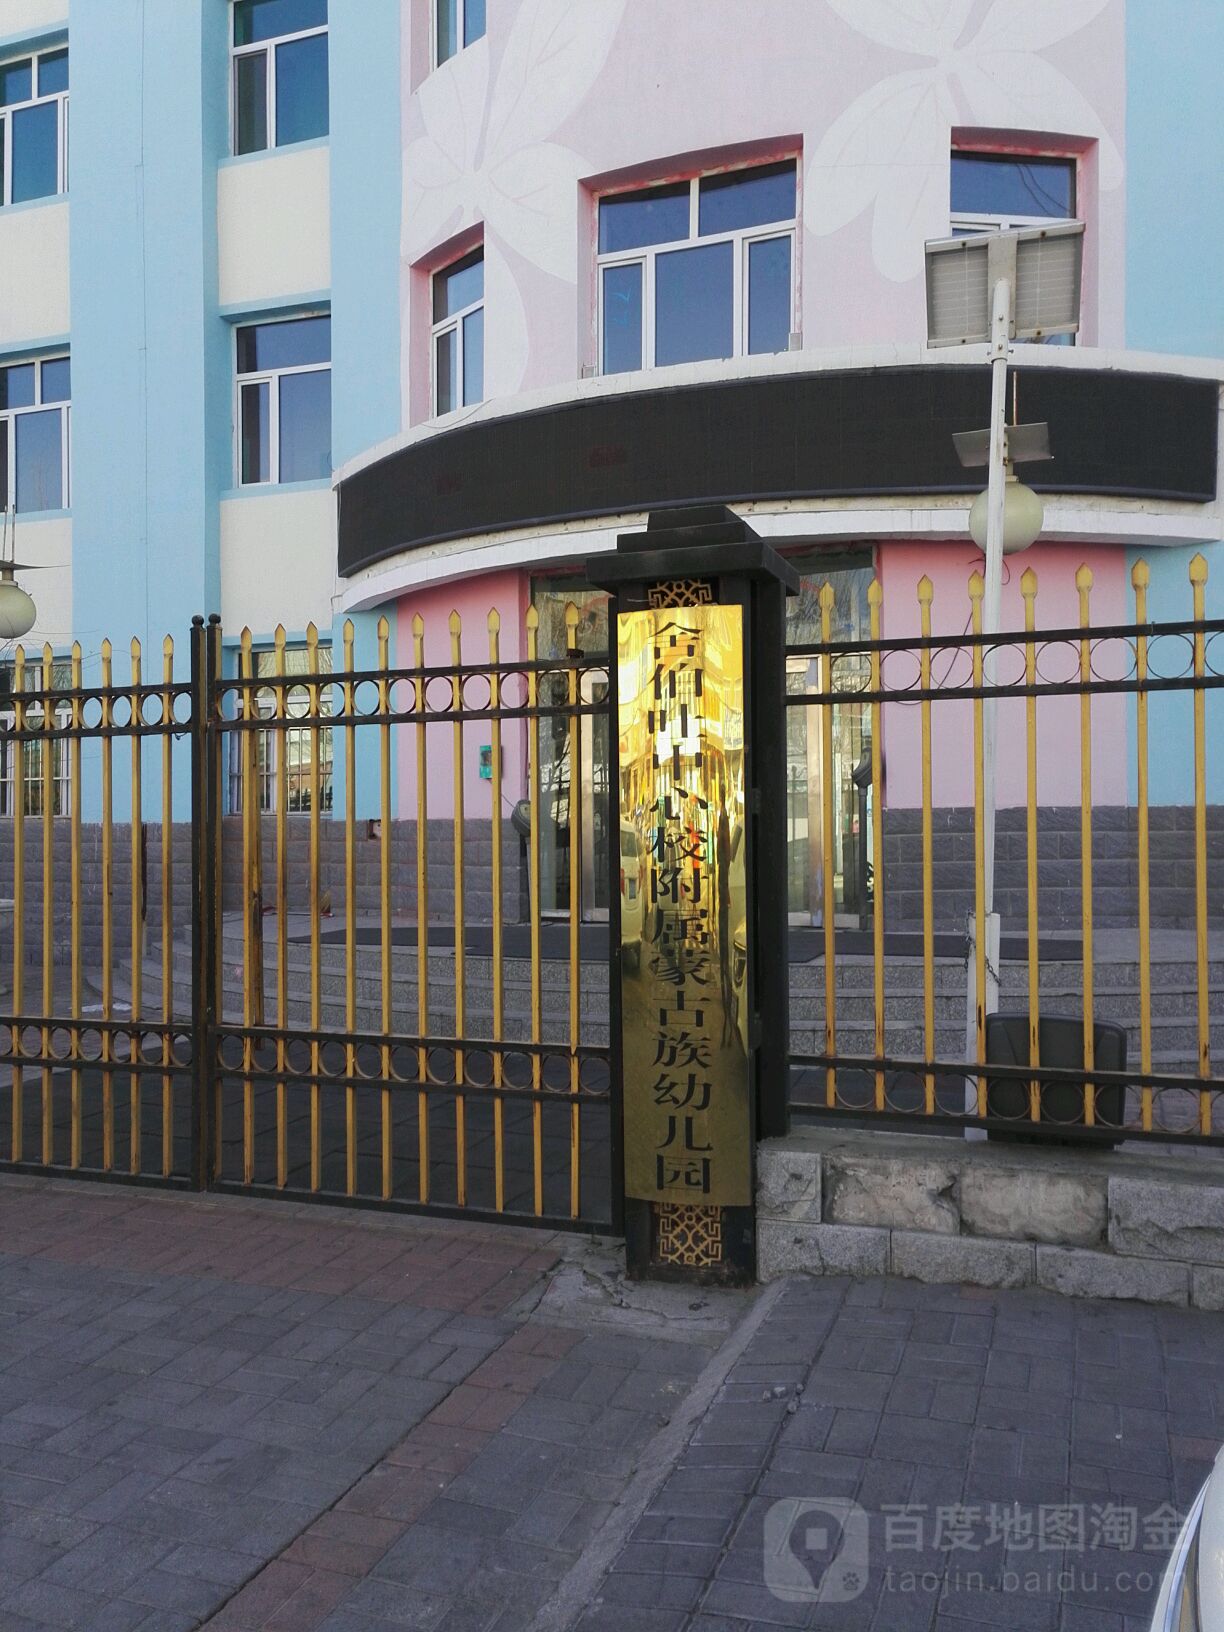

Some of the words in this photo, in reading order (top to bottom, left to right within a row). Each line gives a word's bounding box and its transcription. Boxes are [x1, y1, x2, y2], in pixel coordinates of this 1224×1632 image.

[648, 622, 713, 1194] 舍伯吐中心校附属蒙古族幼儿园
